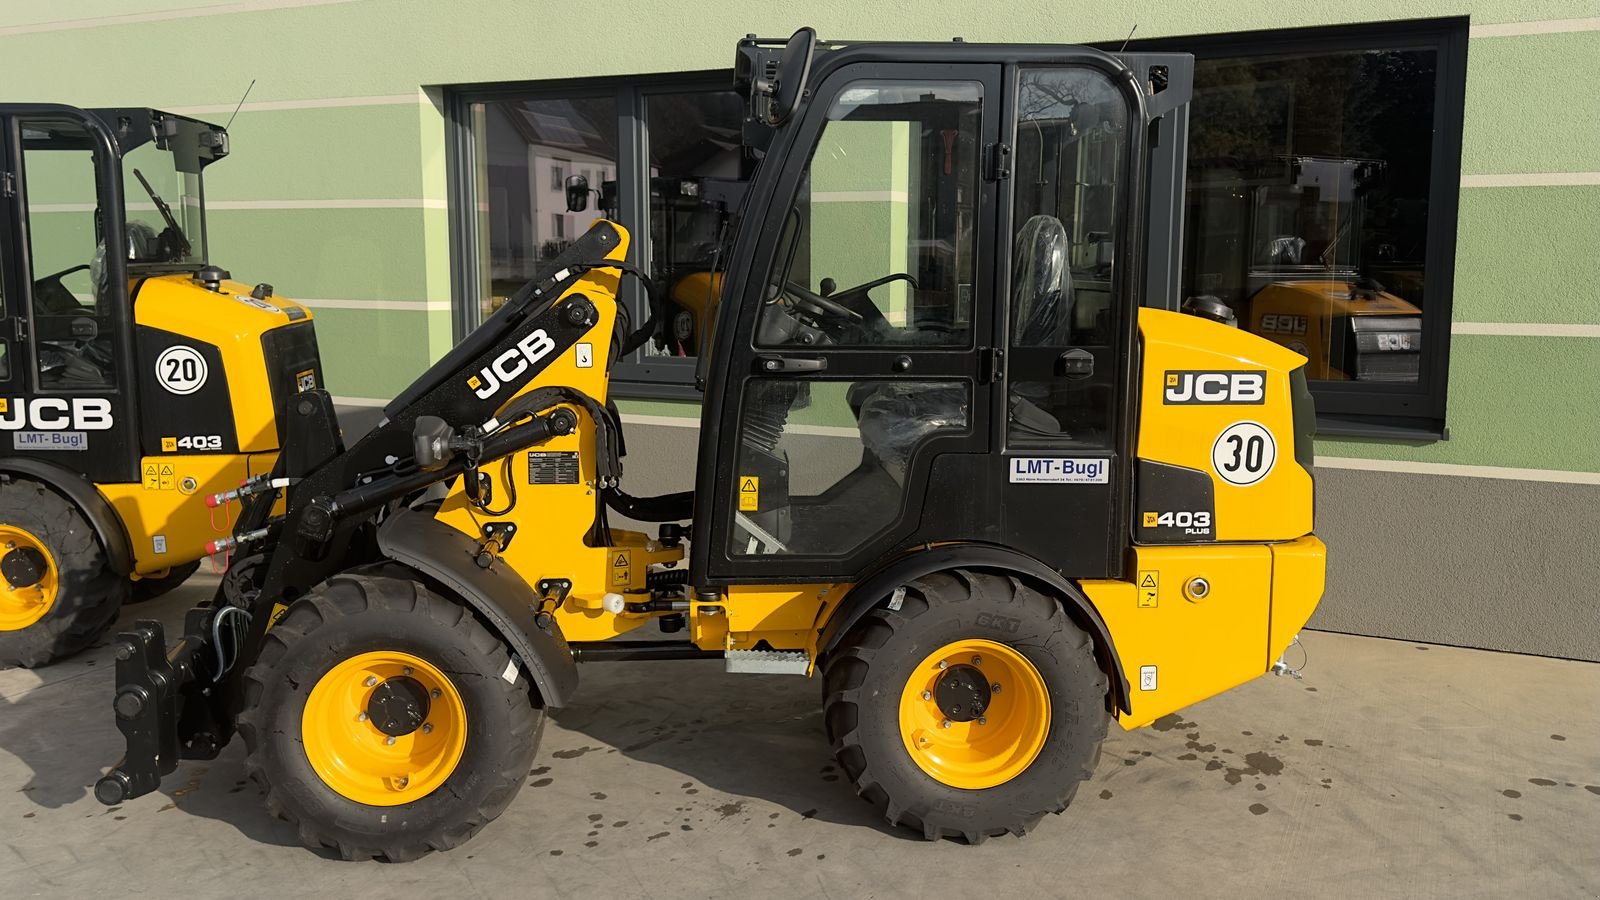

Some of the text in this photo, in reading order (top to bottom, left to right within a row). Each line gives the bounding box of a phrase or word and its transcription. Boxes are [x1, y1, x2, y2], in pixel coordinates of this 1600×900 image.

[166, 358, 197, 382] 20
[475, 329, 556, 399] JCB
[1166, 373, 1263, 402] JCB
[0, 398, 114, 430] JCB
[178, 435, 222, 449] 403
[1223, 434, 1265, 473] 30
[1016, 459, 1103, 478] LMT-Bugl
[1158, 511, 1211, 528] 403
[1185, 527, 1210, 535] PLUS
